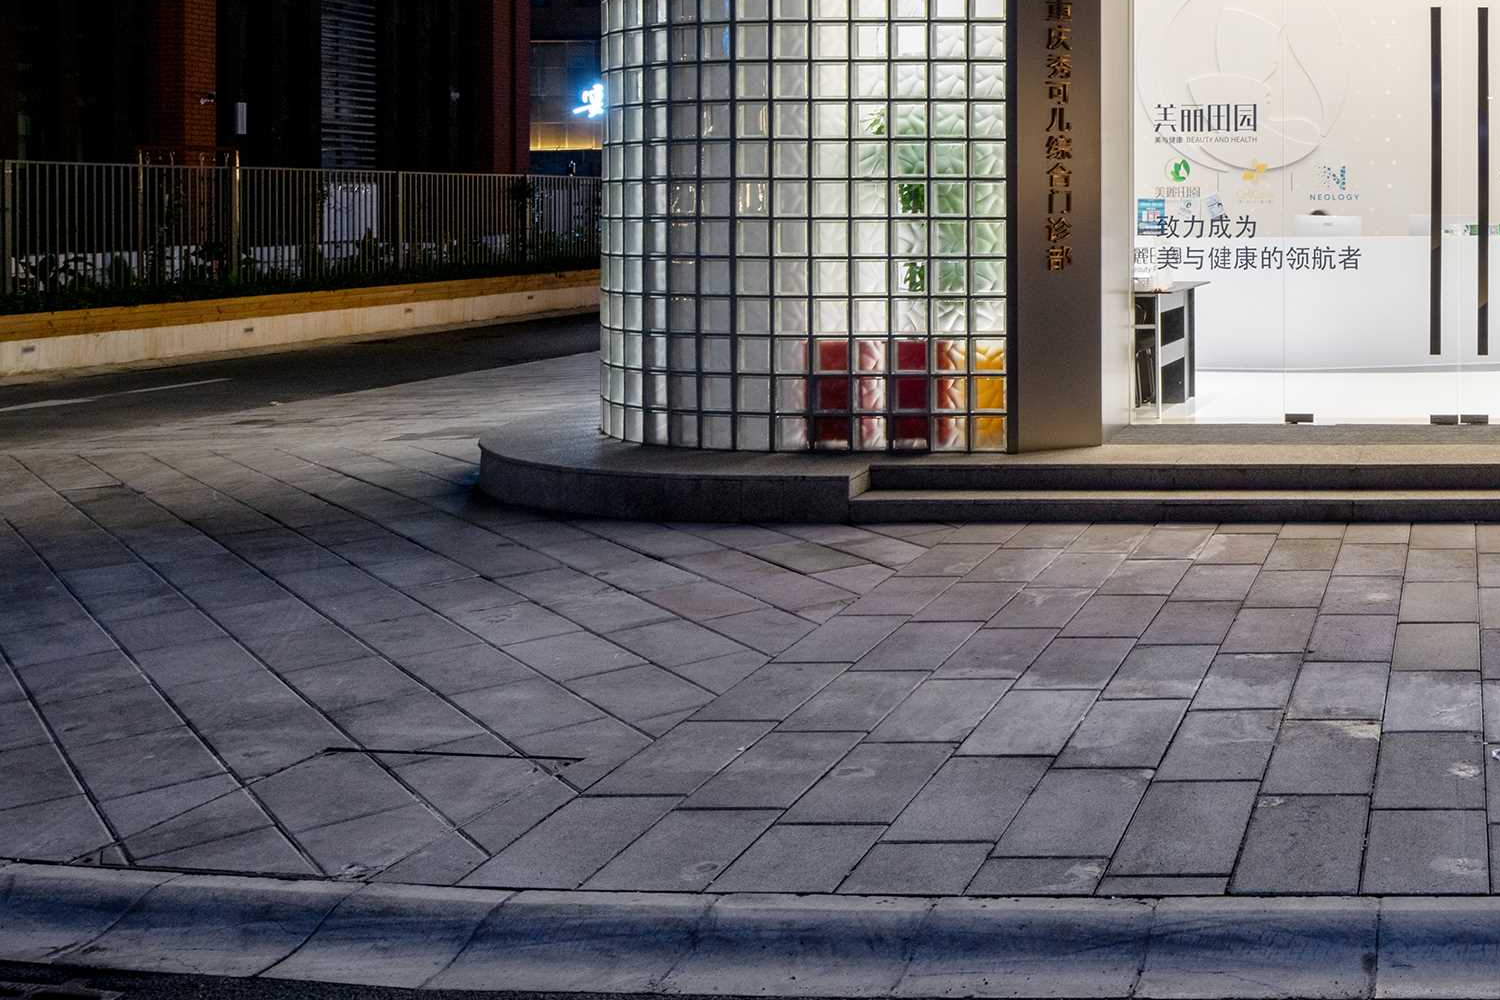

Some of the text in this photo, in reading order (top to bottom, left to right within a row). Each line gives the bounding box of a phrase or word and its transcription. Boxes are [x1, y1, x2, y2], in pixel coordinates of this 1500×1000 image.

[1153, 104, 1257, 132] 美丽田园
[1309, 193, 1360, 201] NEOLOGY
[1156, 214, 1257, 239] 致力成为
[1156, 246, 1362, 271] 美与健康的领航者
